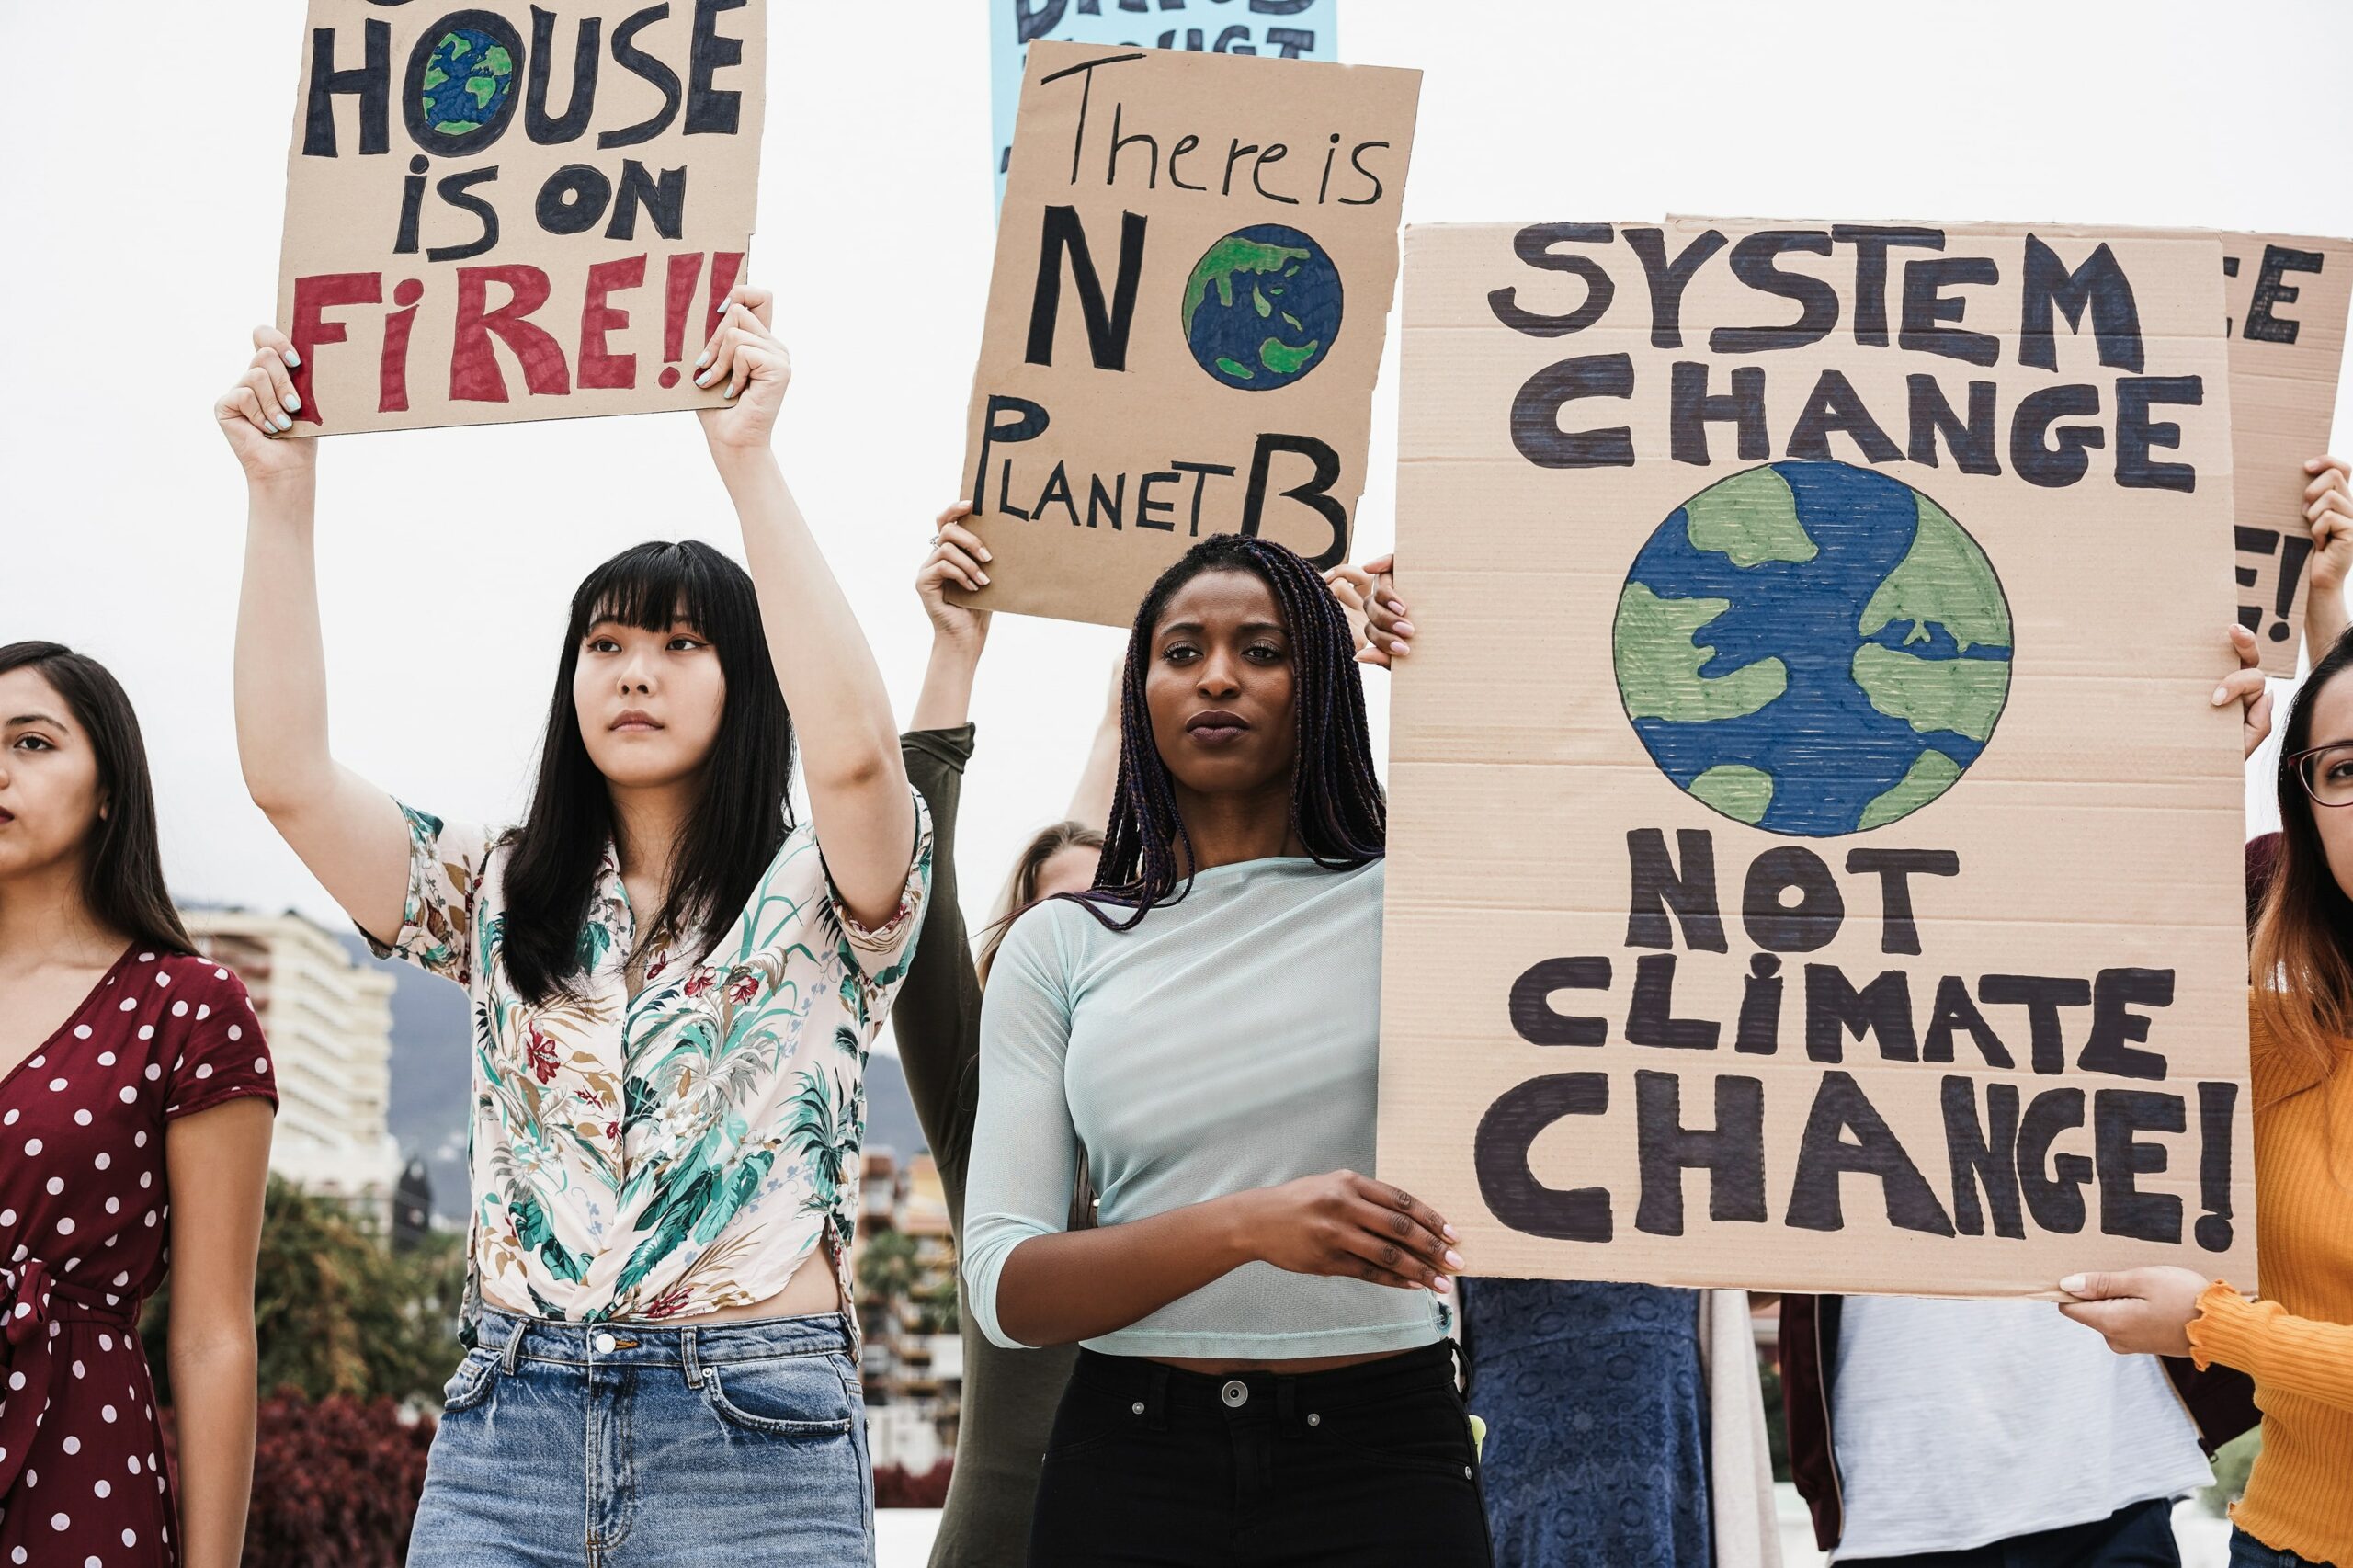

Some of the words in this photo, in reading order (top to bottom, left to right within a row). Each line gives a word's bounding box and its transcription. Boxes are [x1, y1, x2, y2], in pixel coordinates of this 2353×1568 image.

[302, 0, 747, 157] HOUSE
[1040, 52, 1299, 204] There
[1318, 133, 1390, 205] is
[536, 159, 687, 240] ON
[1487, 222, 2144, 374] SYSTEM
[972, 395, 1235, 536] PLANET
[1241, 433, 1347, 572] B
[1510, 353, 2203, 493] CHANGE
[1624, 827, 1960, 956] NOT
[1474, 1069, 2238, 1252] CHANGE!
